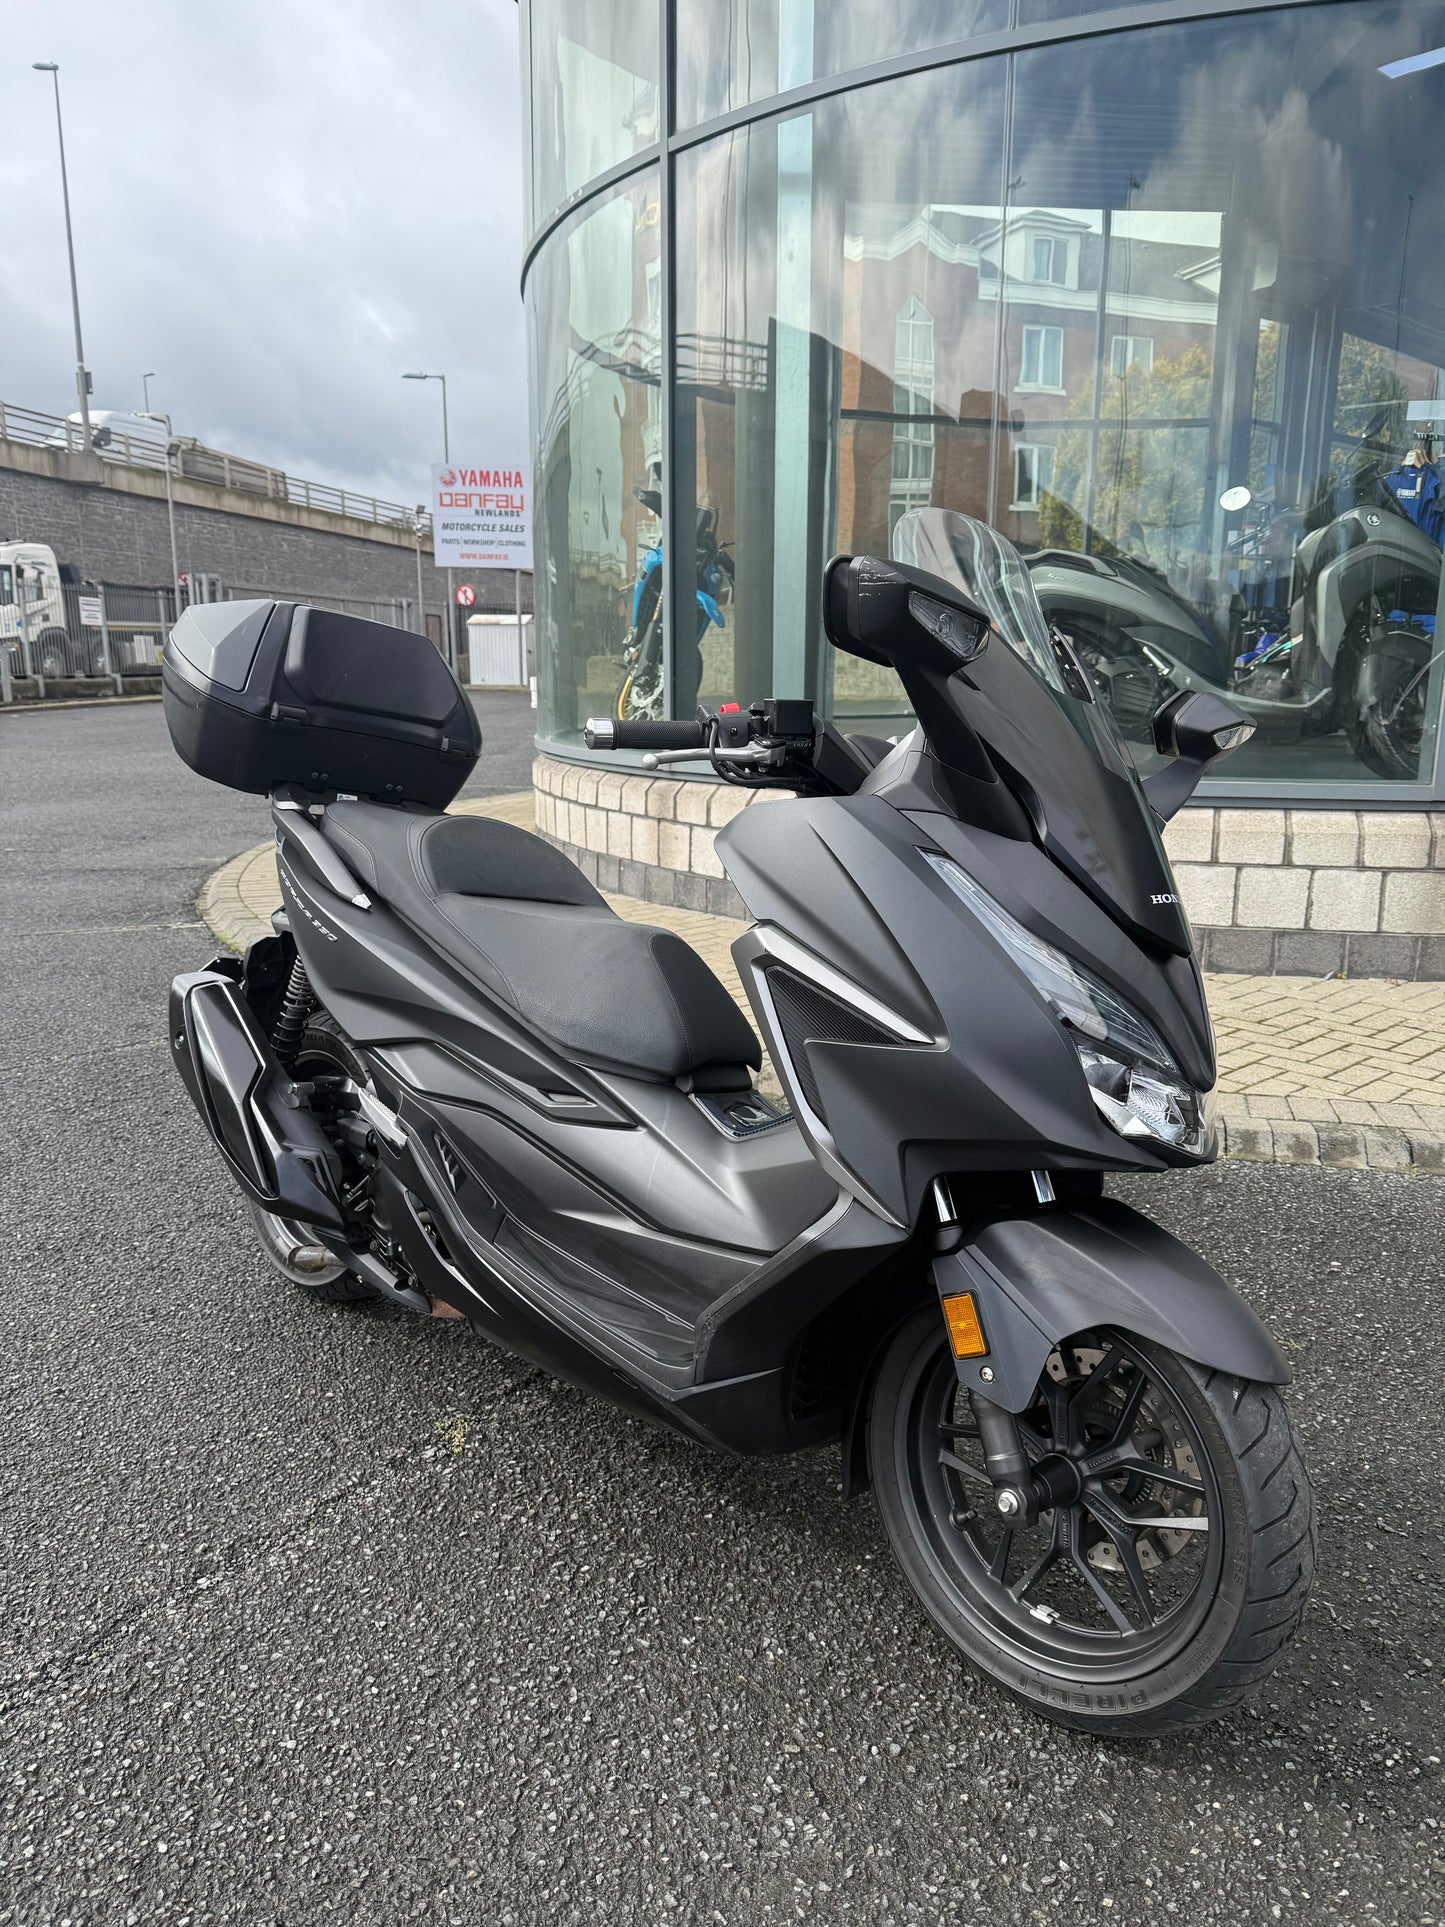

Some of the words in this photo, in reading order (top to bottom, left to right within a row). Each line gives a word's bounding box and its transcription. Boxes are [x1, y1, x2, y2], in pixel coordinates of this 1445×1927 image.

[459, 469, 523, 488] YAMAHA
[475, 509, 521, 518] NEWLANDS
[442, 522, 497, 533] MOTORCYCLE
[499, 524, 525, 533] SALES
[1017, 1672, 1150, 1712] PIRELLI
